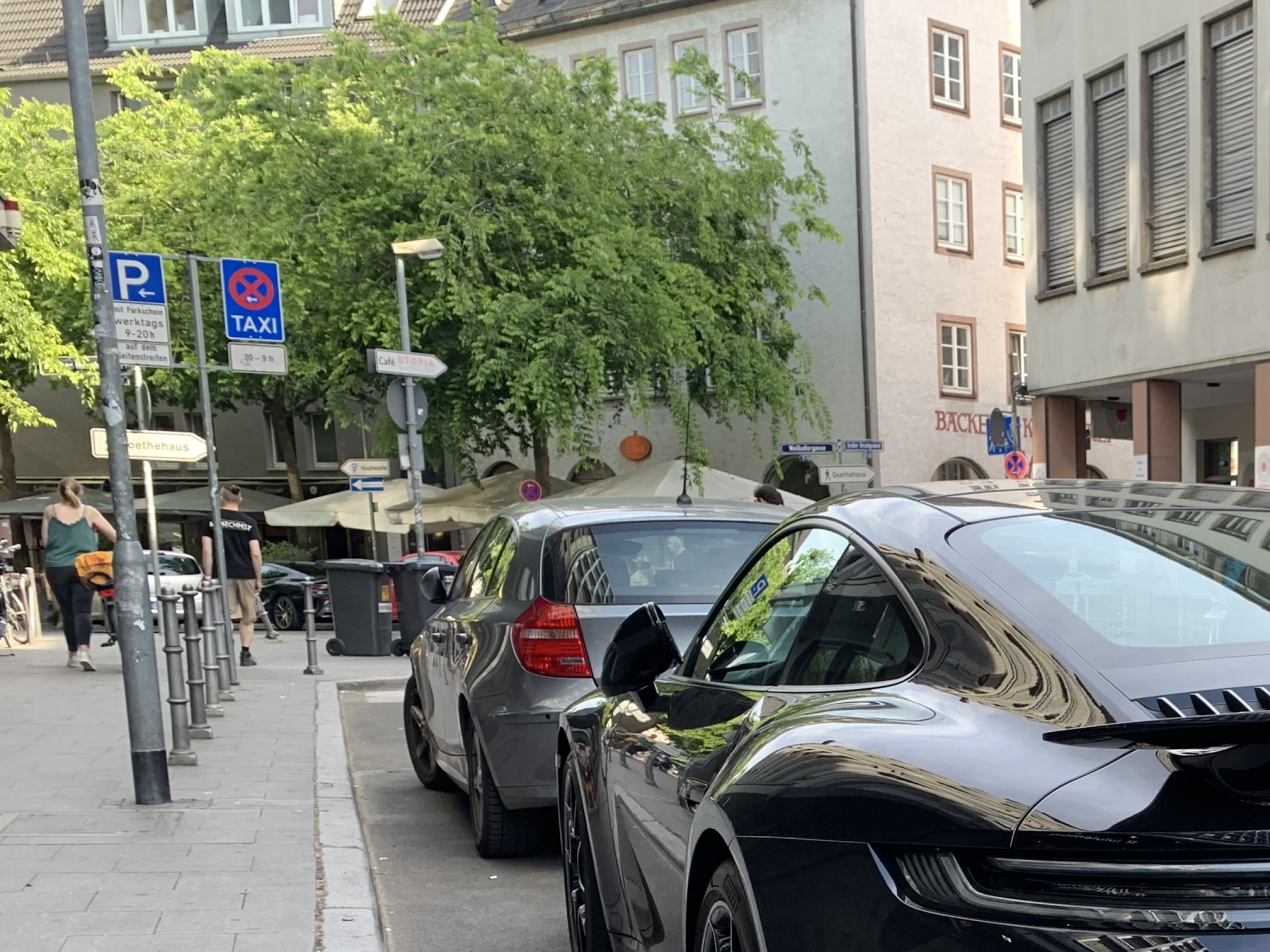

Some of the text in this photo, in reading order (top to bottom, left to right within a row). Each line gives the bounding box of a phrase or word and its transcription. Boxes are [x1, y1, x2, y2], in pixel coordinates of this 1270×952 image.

[116, 258, 150, 300] P
[126, 306, 163, 316] Parkschein
[115, 317, 164, 329] werktags
[231, 314, 278, 334] TAXI
[125, 343, 157, 352] auf dem
[118, 351, 168, 362] Seitenstreifen
[243, 353, 253, 362] 20
[261, 354, 267, 362] 9
[268, 354, 274, 363] h
[378, 355, 435, 368] Café UTOPIA
[128, 441, 189, 452] oethehaus
